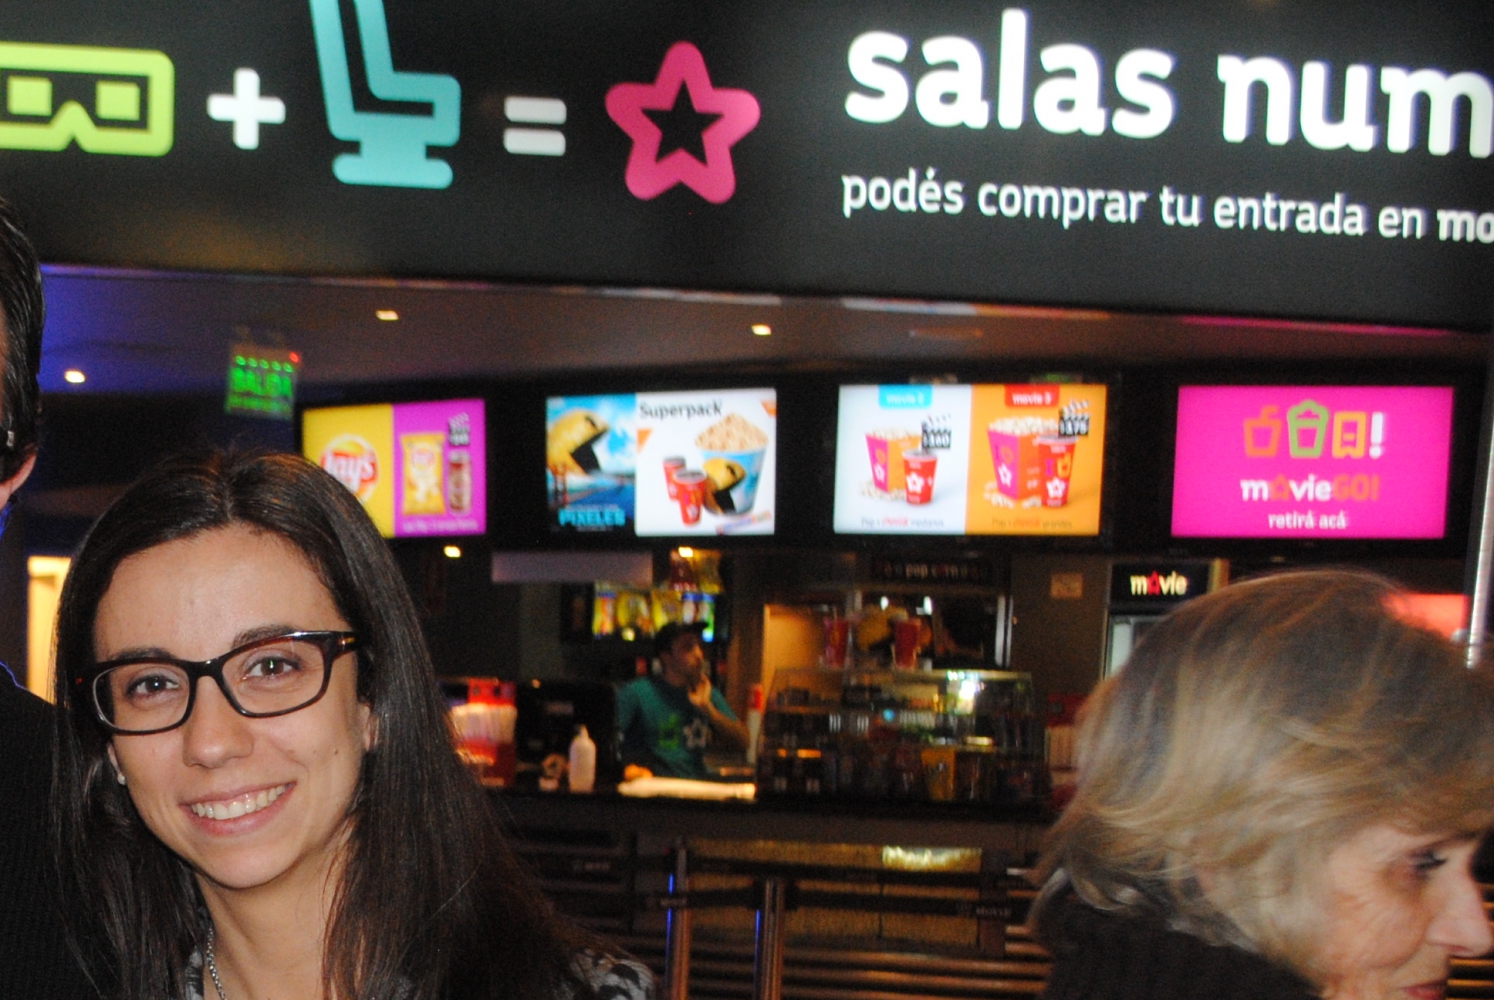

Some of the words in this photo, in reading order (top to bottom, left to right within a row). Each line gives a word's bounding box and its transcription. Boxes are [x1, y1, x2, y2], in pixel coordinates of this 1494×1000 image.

[844, 8, 1177, 139] salas
[1217, 55, 1494, 159] num
[841, 166, 966, 220] podés
[978, 182, 1150, 230] comprar
[1159, 185, 1204, 228] tu
[1213, 192, 1368, 237] entrada
[1378, 206, 1426, 241] en
[638, 400, 723, 421] Superpack
[1268, 510, 1315, 529] retirá
[1319, 511, 1348, 529] acá
